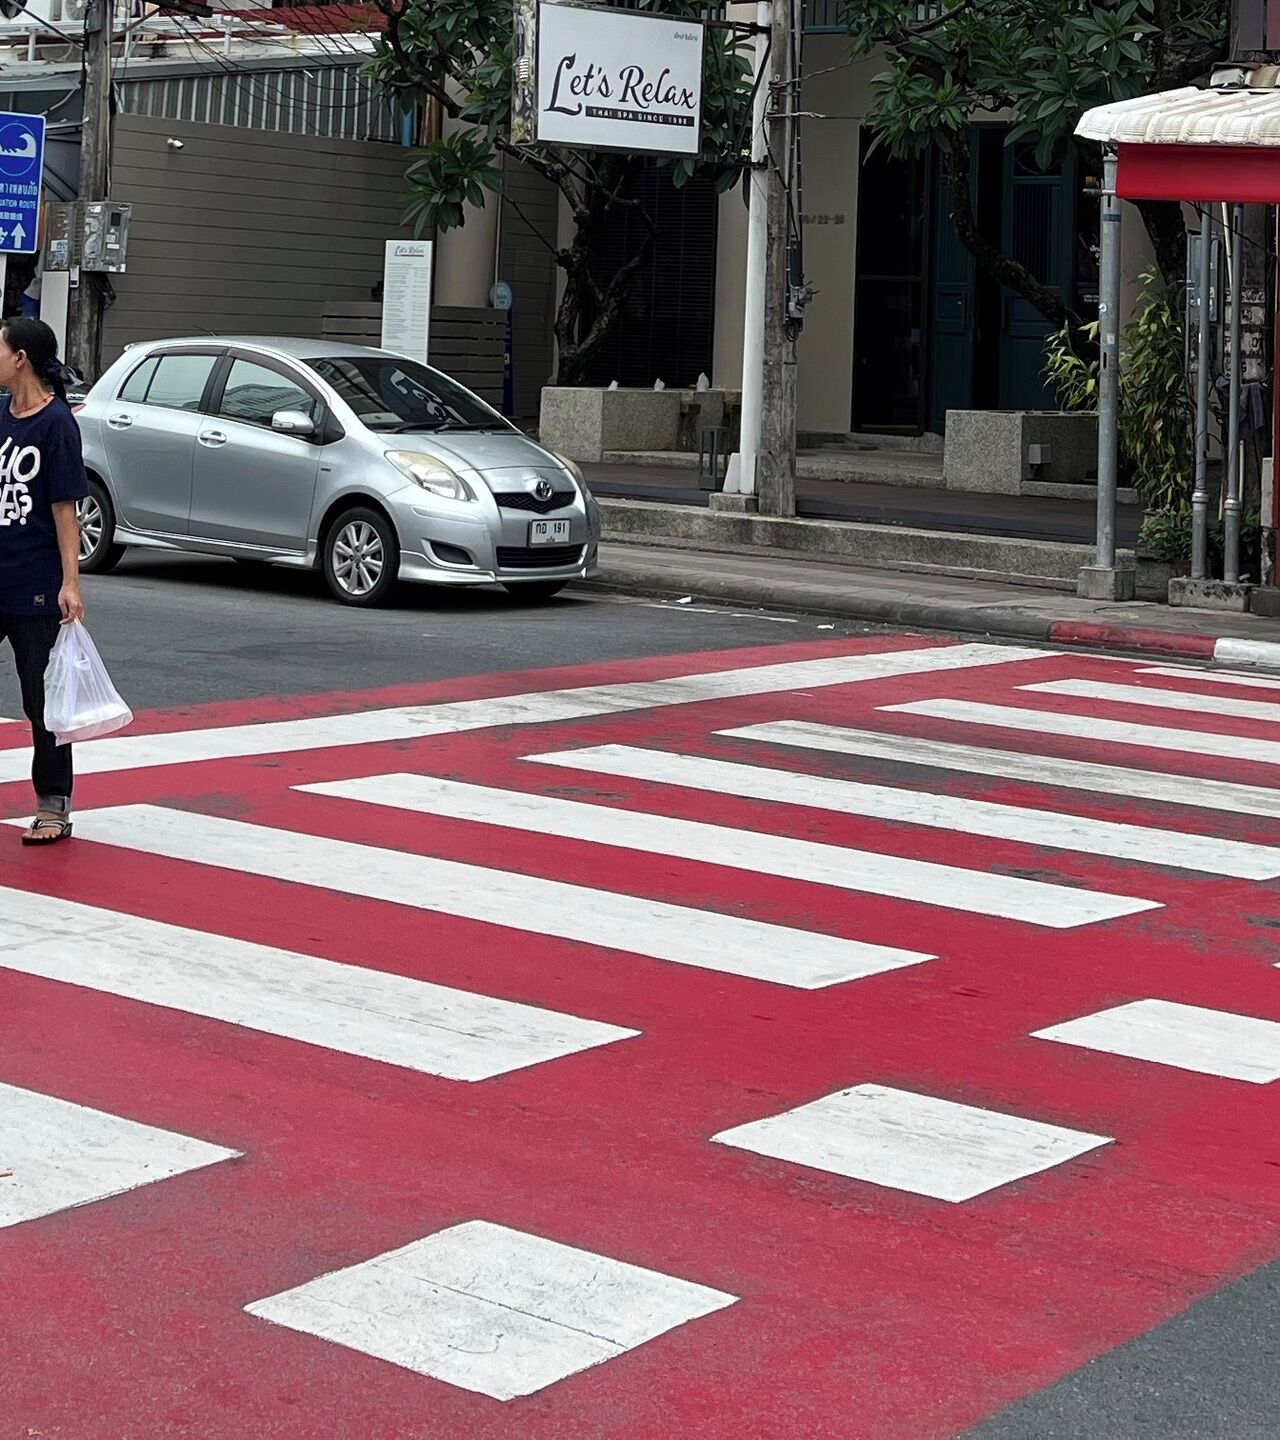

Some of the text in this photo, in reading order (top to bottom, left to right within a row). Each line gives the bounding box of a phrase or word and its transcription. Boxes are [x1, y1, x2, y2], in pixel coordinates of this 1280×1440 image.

[543, 52, 698, 116] Let's Relax
[638, 113, 664, 122] SINCE
[553, 522, 566, 534] 191
